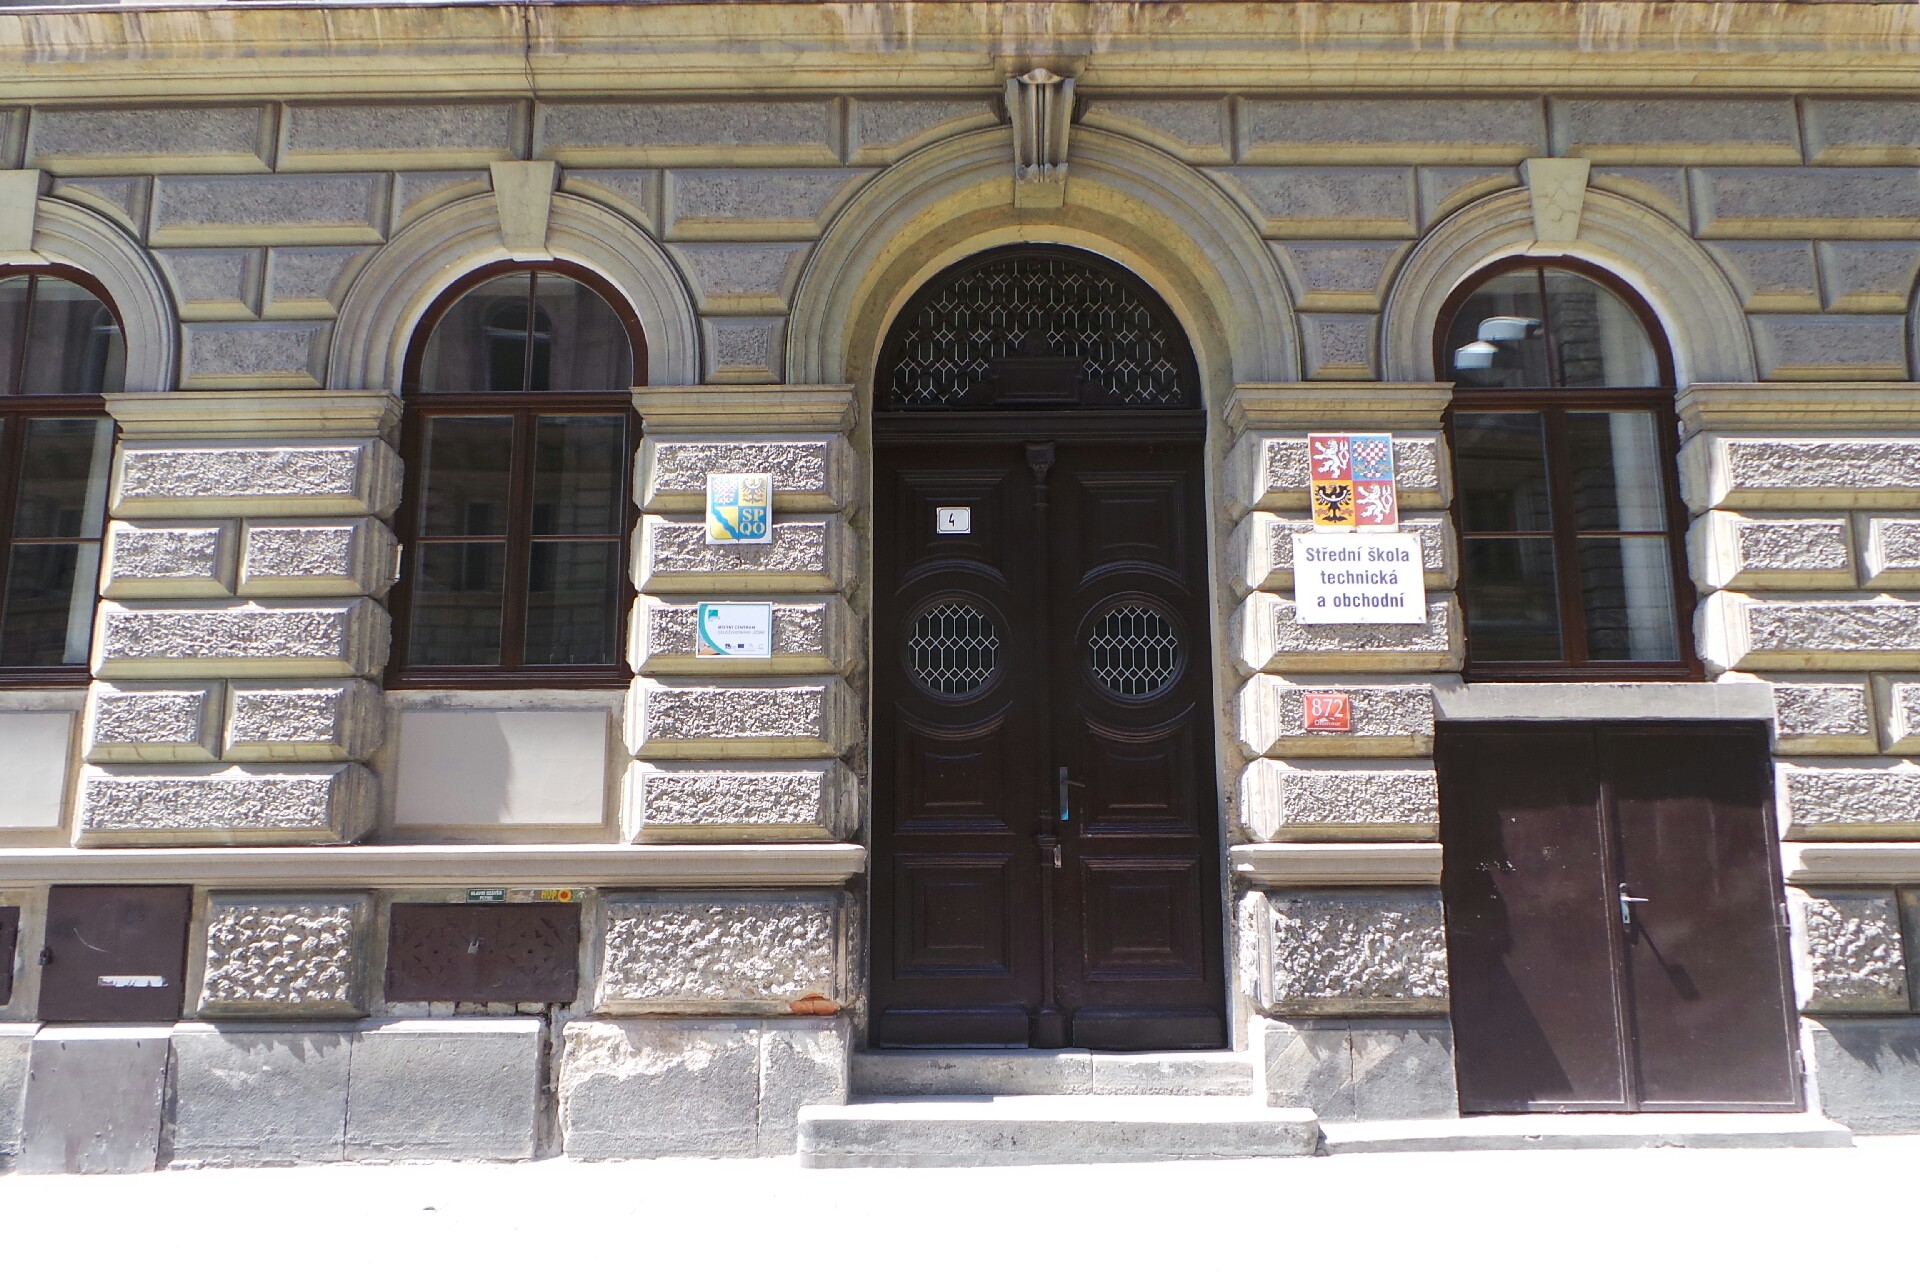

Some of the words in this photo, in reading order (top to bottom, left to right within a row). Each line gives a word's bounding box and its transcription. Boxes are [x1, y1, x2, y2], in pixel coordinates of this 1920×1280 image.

[742, 508, 764, 522] SP
[948, 512, 955, 527] 4
[739, 522, 765, 536] QO
[1305, 546, 1363, 562] Střední
[1367, 546, 1410, 562] škola
[1320, 569, 1399, 585] technická
[1317, 596, 1326, 607] a
[1333, 592, 1405, 607] obchodní
[1311, 698, 1344, 718] 872
